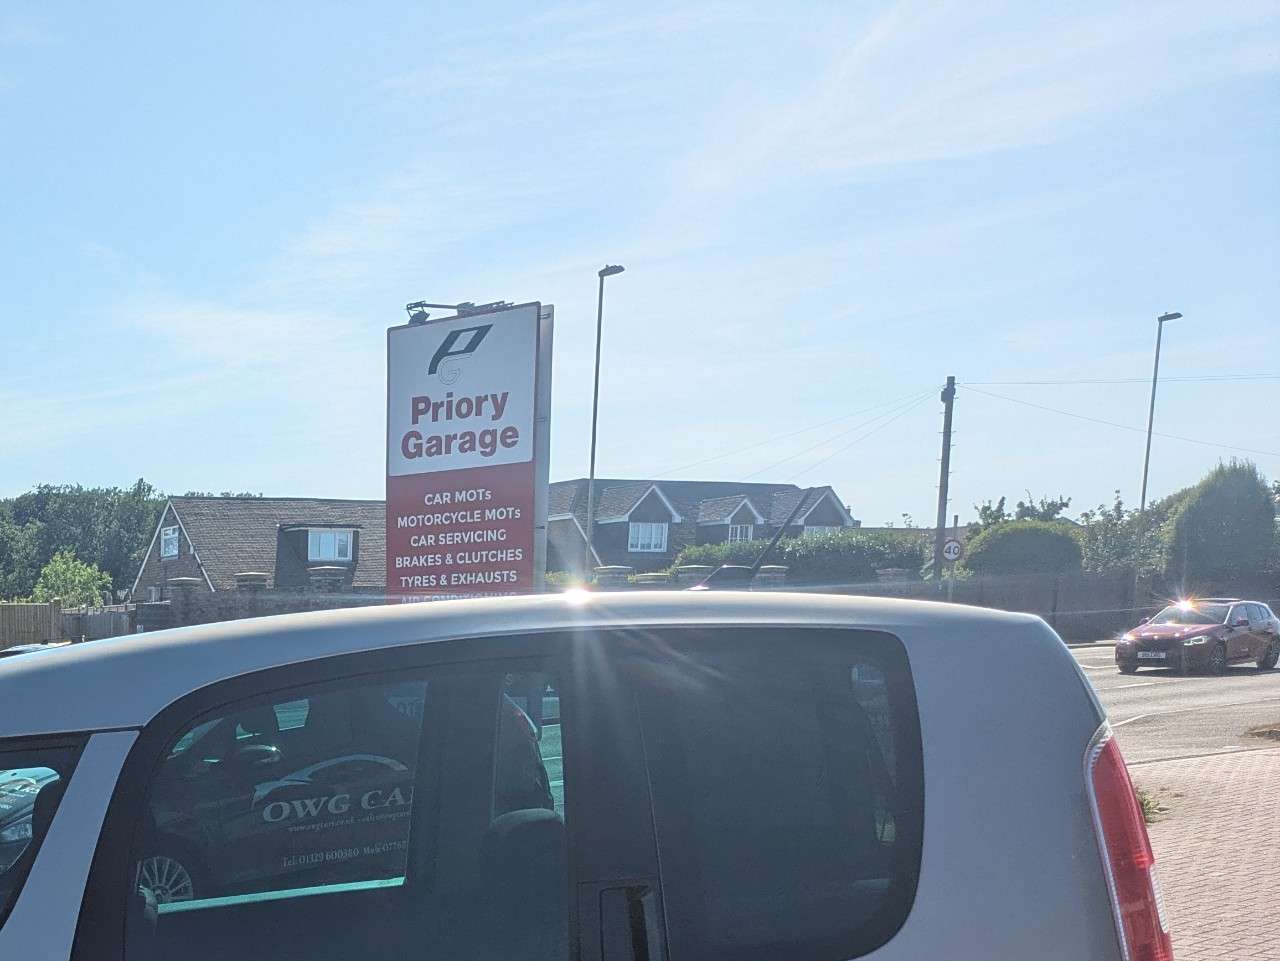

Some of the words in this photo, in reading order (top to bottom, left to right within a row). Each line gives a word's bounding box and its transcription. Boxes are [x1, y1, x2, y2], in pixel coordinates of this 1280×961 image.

[411, 391, 509, 425] Priory
[401, 426, 519, 460] Garage
[424, 492, 451, 506] CAR
[455, 489, 492, 503] MOTs
[397, 510, 481, 529] MOTORCYCLE
[485, 507, 521, 521] MOTs
[410, 534, 436, 547] CAR
[438, 529, 507, 545] SERVICING
[395, 553, 442, 568] BRAKES
[445, 553, 453, 565] &
[456, 548, 523, 564] CLUTCHES
[945, 545, 959, 555] 40
[400, 575, 437, 588] TYRES
[440, 574, 448, 585] &
[451, 570, 518, 585] EXHAUSTS
[262, 793, 351, 822] OWG
[360, 787, 411, 810] CA
